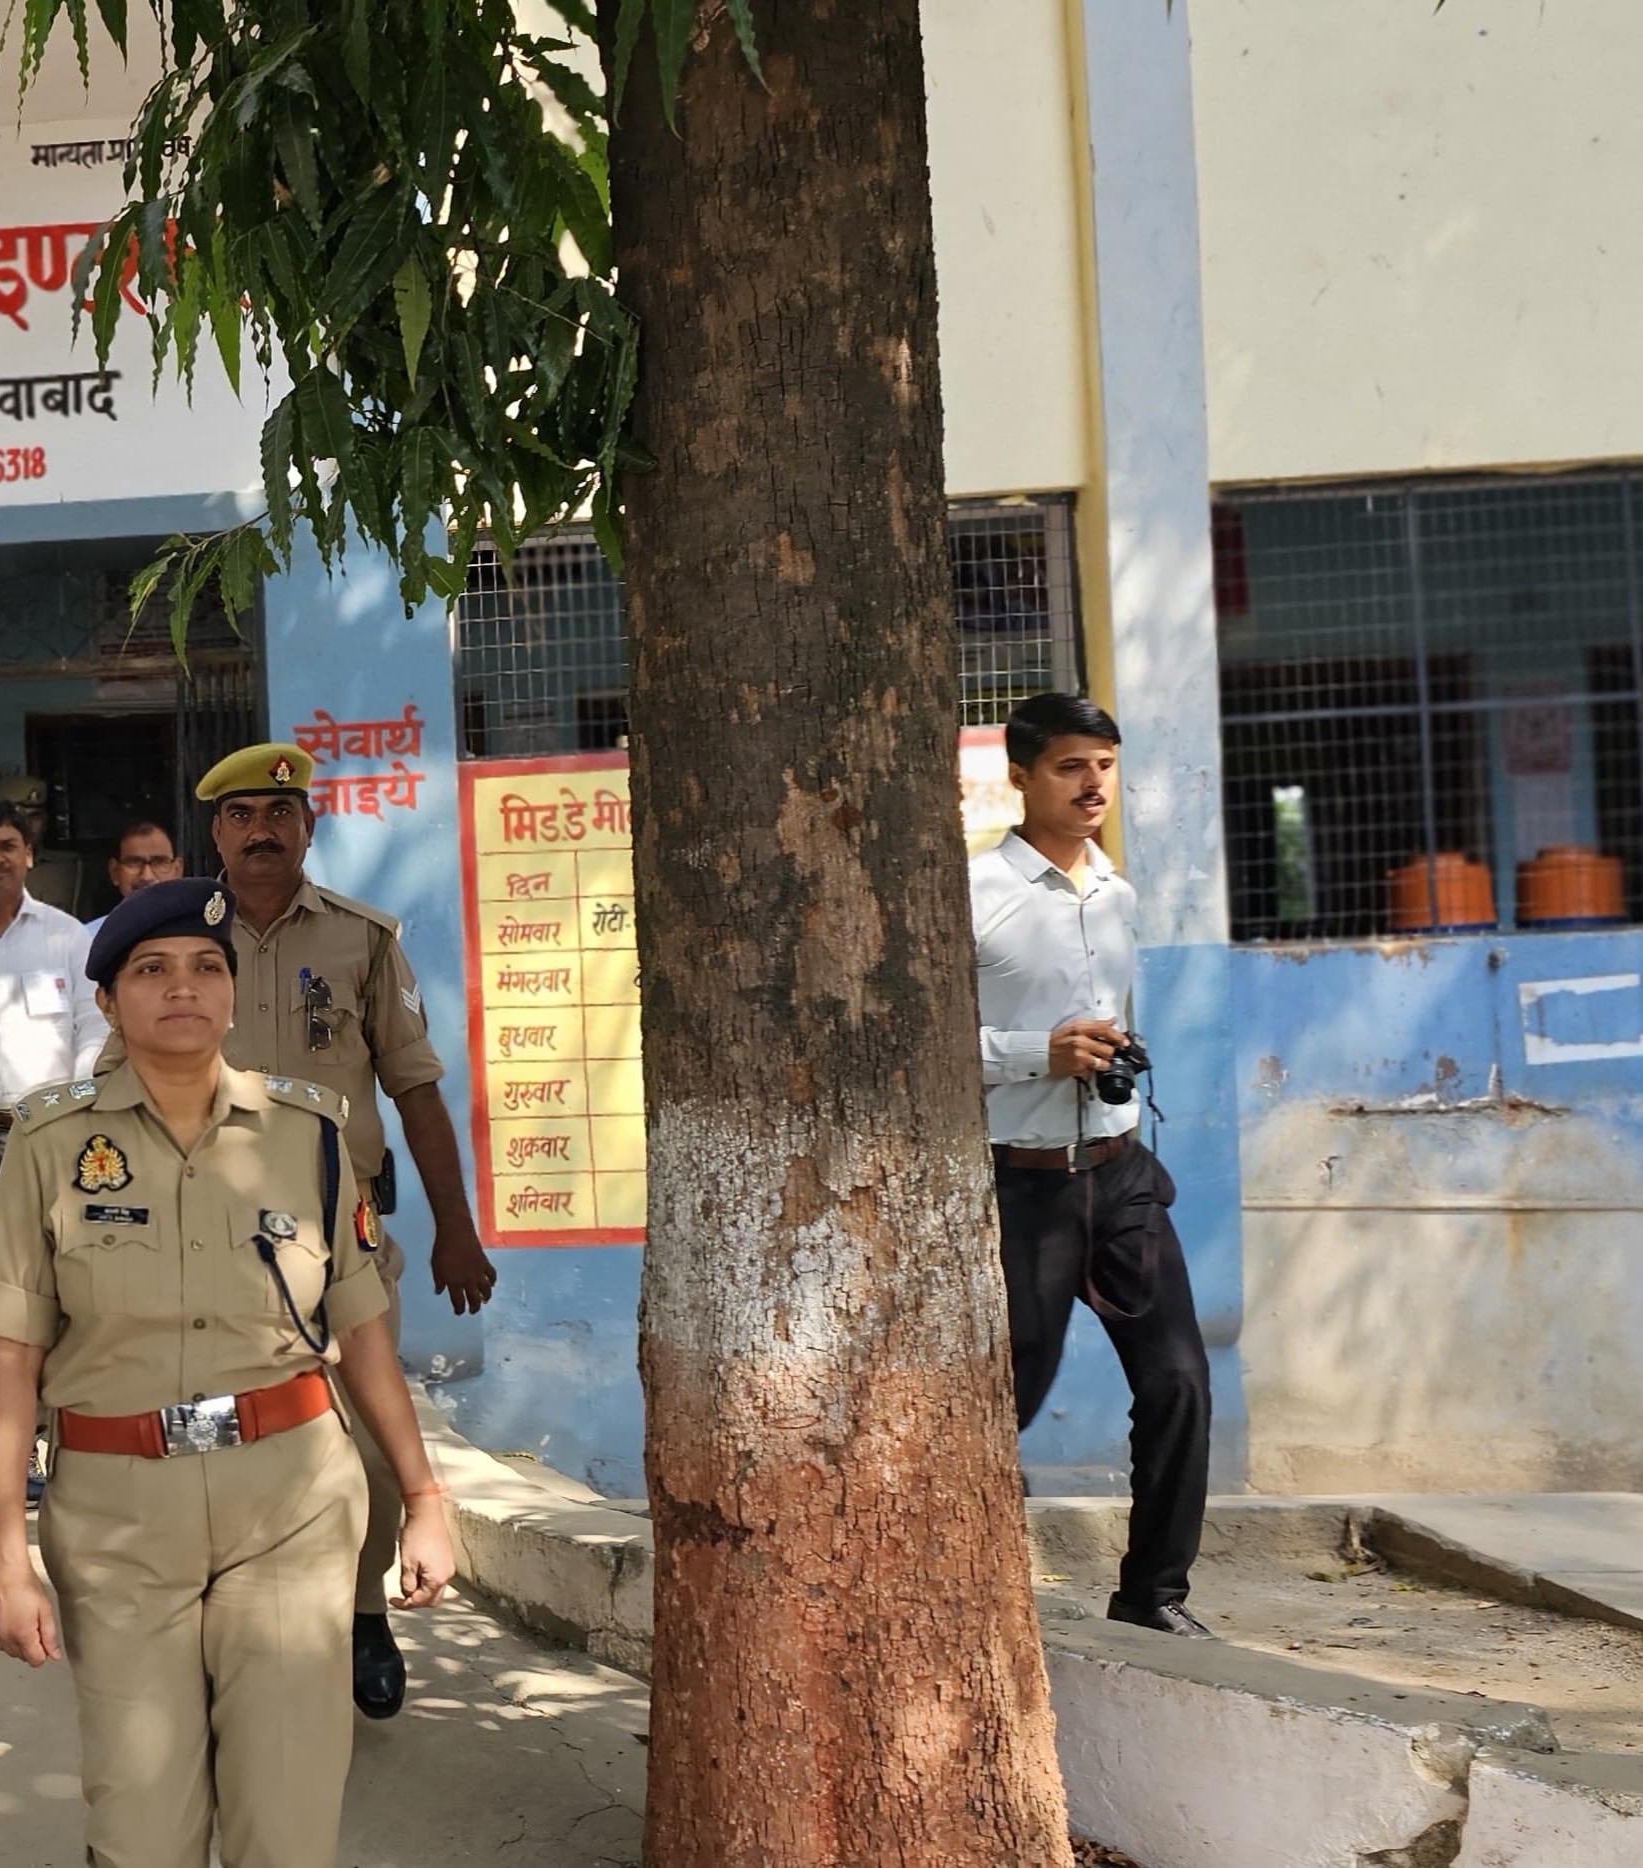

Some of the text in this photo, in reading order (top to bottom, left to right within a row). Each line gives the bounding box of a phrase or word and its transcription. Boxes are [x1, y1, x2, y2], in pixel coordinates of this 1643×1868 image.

[30, 140, 105, 168] मान्यता
[292, 703, 425, 765] सेवार्थ
[309, 760, 425, 822] जाइये
[506, 872, 552, 900] दिन
[497, 915, 562, 947] सोमवार
[496, 964, 572, 996] मंगलवार
[498, 1025, 557, 1057] बुधवार
[506, 1186, 575, 1218] शनिवार
